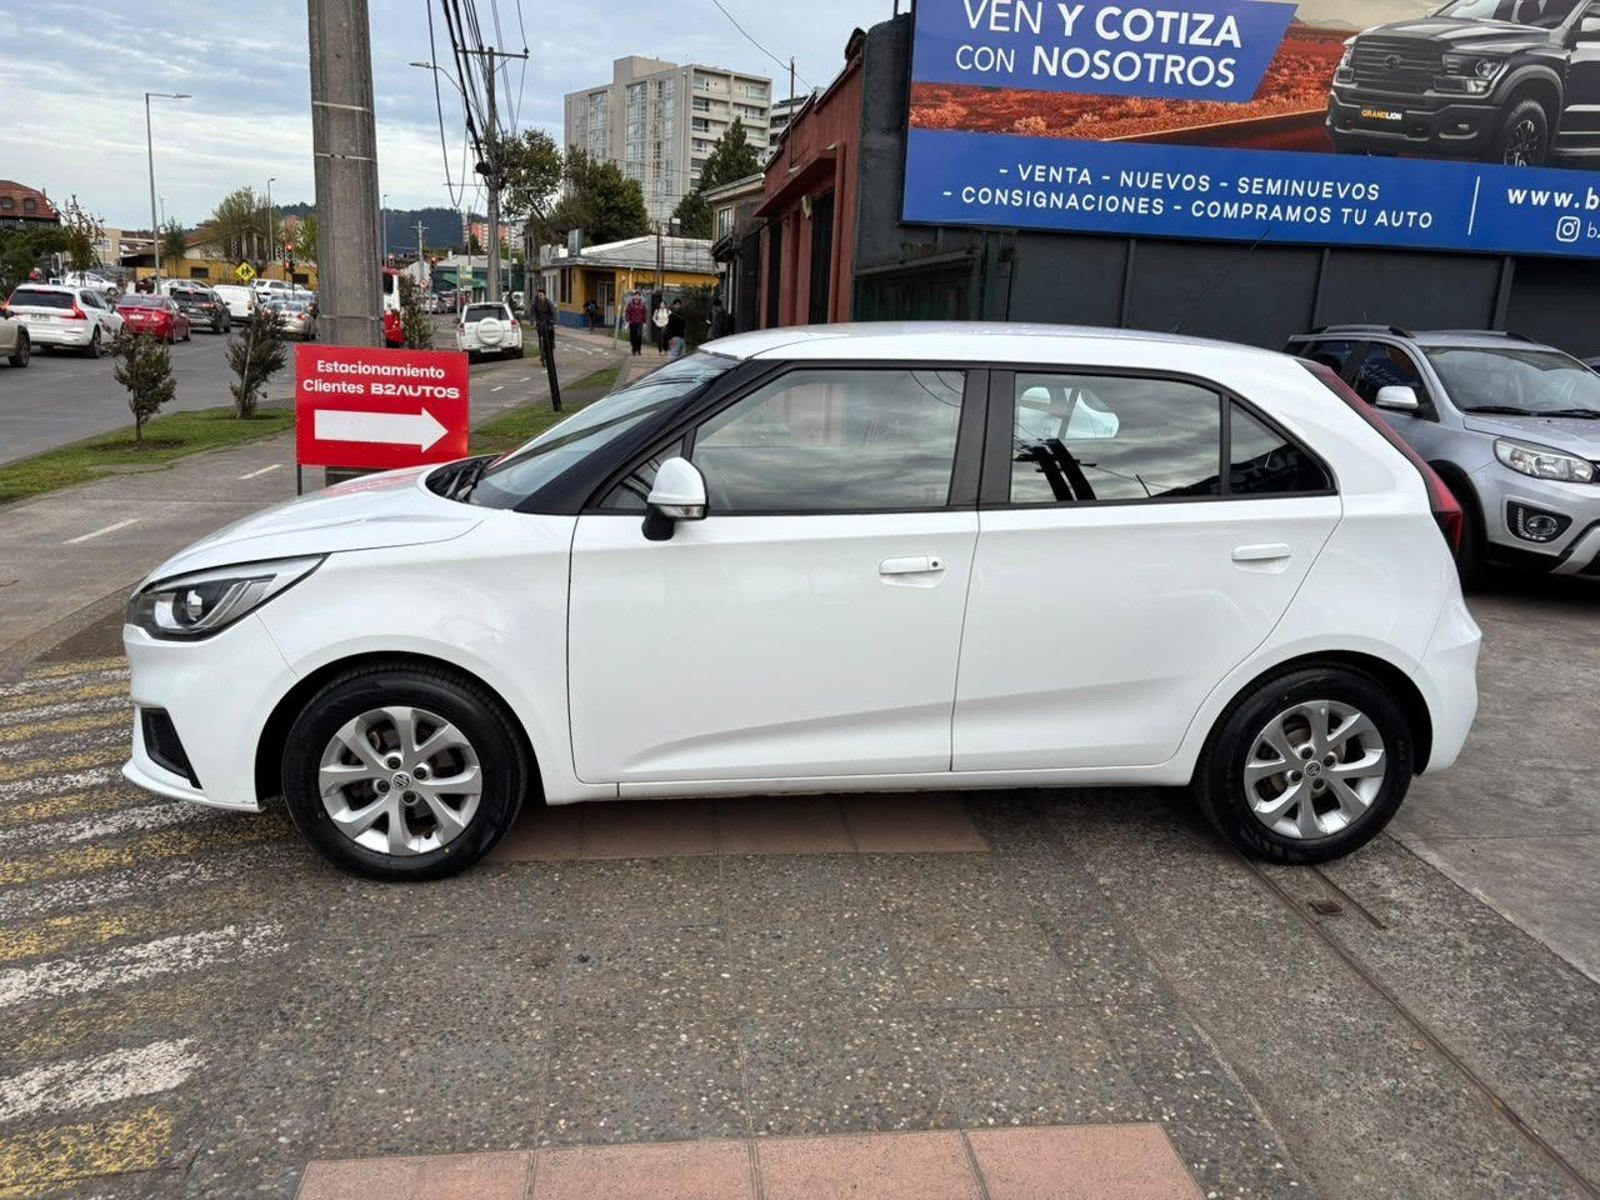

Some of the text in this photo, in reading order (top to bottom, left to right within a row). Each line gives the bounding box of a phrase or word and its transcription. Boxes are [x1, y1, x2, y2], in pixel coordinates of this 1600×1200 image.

[963, 0, 1242, 48] VEN Y COTIZA
[955, 45, 1236, 89] CON NOSOTROS
[1018, 163, 1092, 185] VENTA
[1120, 170, 1210, 192] NUEVOS
[1237, 176, 1380, 200] SEMINUEVOS
[961, 186, 1164, 215] CONSIGNACIONES
[1191, 200, 1331, 224] COMPRAMOS
[1341, 208, 1367, 225] TU
[1375, 211, 1433, 229] AUTO
[303, 379, 460, 399] Clientes B2AUTOS
[317, 360, 445, 379] Estacionamiento
